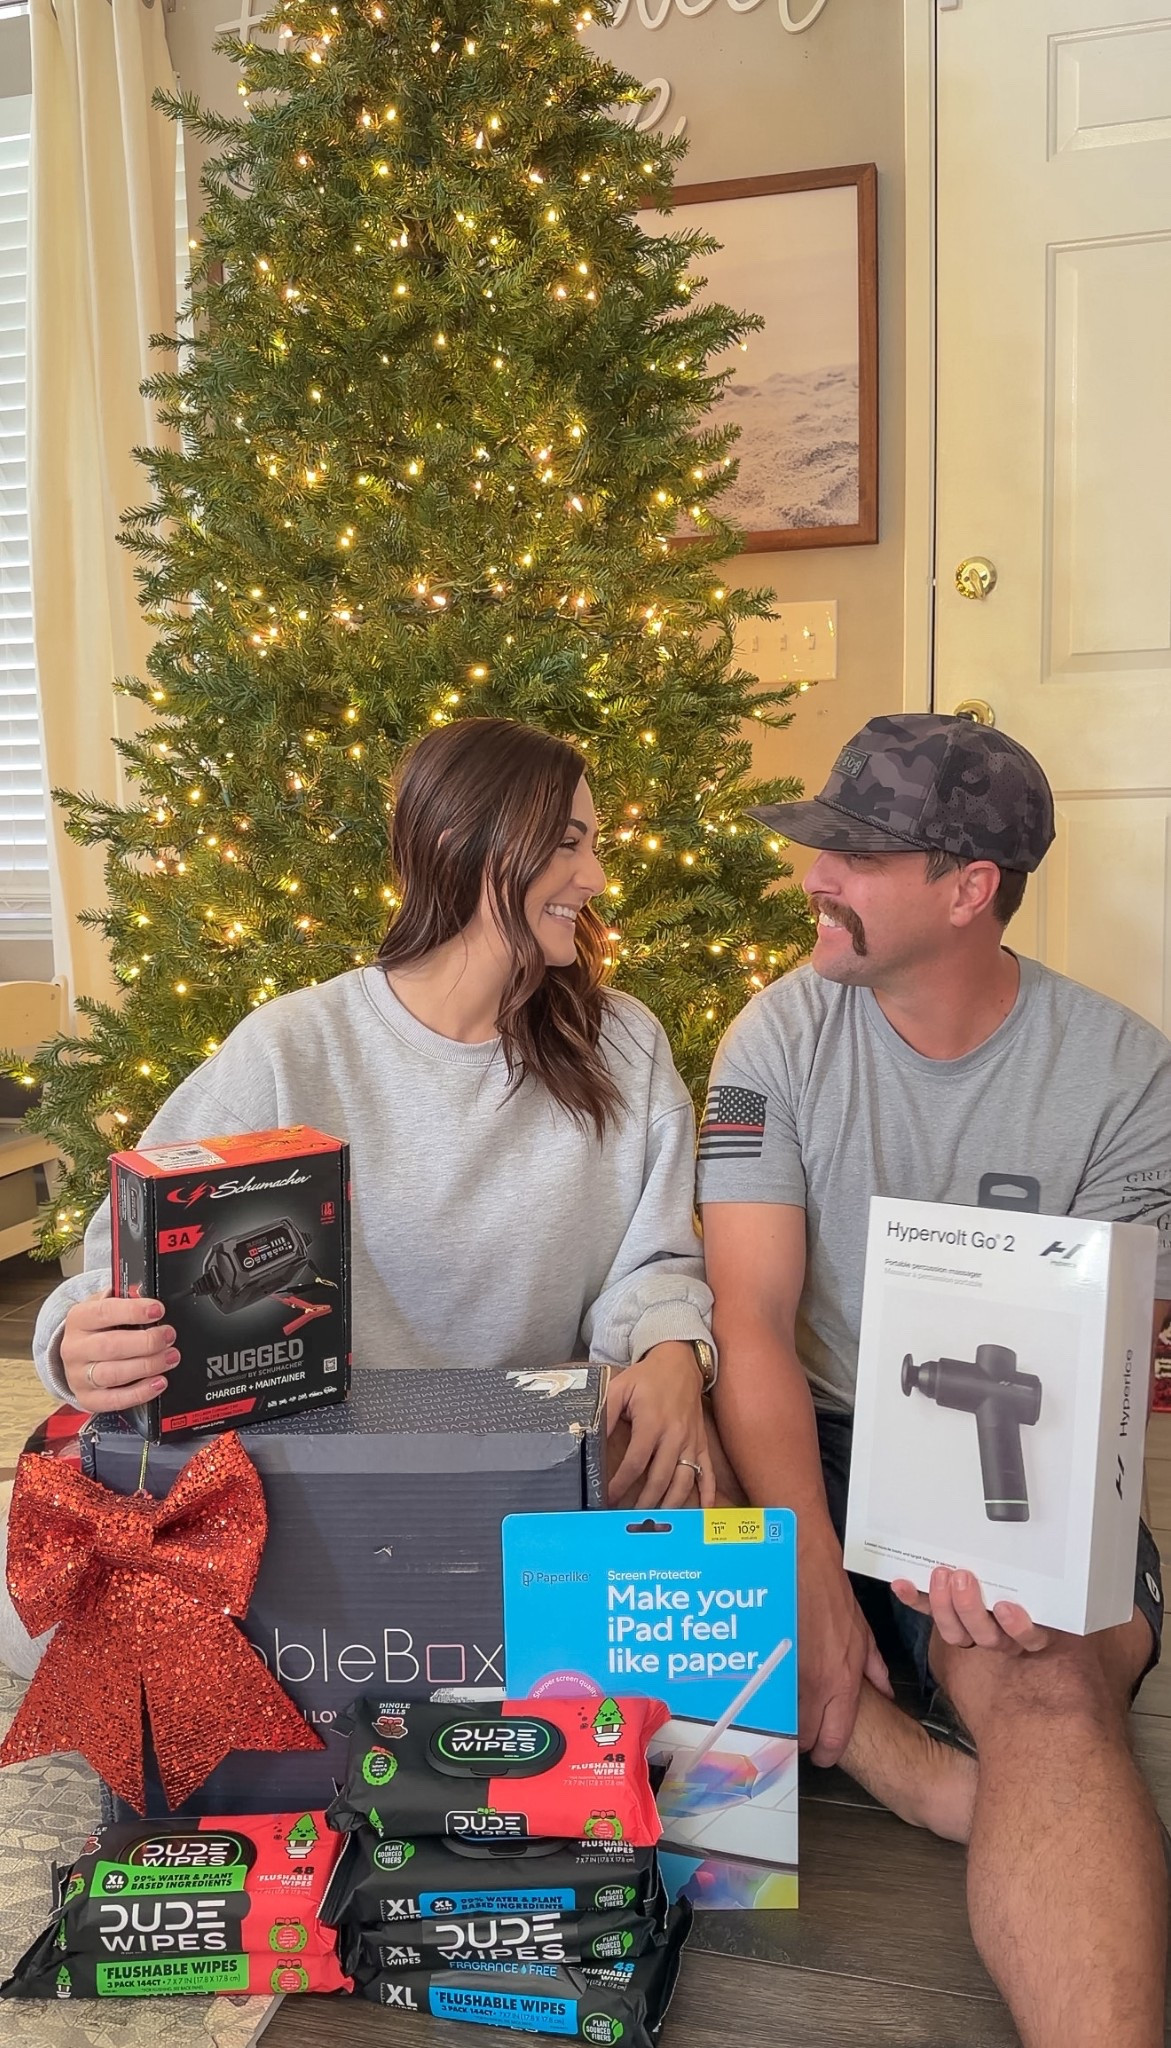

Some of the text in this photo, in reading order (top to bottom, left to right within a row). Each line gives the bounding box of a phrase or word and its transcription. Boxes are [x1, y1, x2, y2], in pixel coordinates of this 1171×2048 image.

[210, 1169, 311, 1199] Schumacher
[887, 1221, 968, 1246] Hypervolt
[1003, 1235, 1015, 1252] 2
[207, 1339, 304, 1379] RUGGED
[258, 1360, 304, 1376] SCHUMACHER
[205, 1385, 247, 1401] CHARGER
[255, 1371, 306, 1390] MAINTAINER
[1120, 1349, 1133, 1436] Hyperice
[771, 1526, 778, 1535] 2
[537, 1572, 589, 1585] Paperlike
[607, 1569, 702, 1581] Screen Protector
[608, 1584, 768, 1616] Make your
[608, 1614, 737, 1642] iPad feel
[608, 1647, 763, 1679] like paper.
[533, 1679, 555, 1699] Sharper
[579, 1680, 598, 1697] quality
[452, 1728, 537, 1742] DUDE
[451, 1741, 535, 1752] WIPES
[603, 1753, 626, 1762] 48
[453, 1816, 521, 1831] DUDE
[143, 1843, 230, 1857] DUDE
[142, 1856, 226, 1867] WIPES
[292, 1866, 315, 1875] 48
[106, 1875, 125, 1885] XL
[131, 1880, 233, 1890] BASED INGREDIENTS
[386, 1899, 421, 1917] XL
[434, 1901, 453, 1909] XL
[461, 1902, 494, 1910] BASED
[100, 1900, 226, 1933] DUDE
[435, 1912, 563, 1950] DUDE
[101, 1932, 227, 1951] WIPES
[602, 1934, 620, 1942] PLANT
[386, 1946, 421, 1958] XL
[438, 1943, 566, 1961] WIPES
[596, 1941, 621, 1950] SOURCED
[601, 1949, 621, 1957] FIBERS
[191, 1960, 237, 1973] WIPES
[386, 1957, 421, 1966] WIPES
[613, 1962, 635, 1972] 48
[450, 1962, 558, 1977] FRAGRANCE FREE
[137, 1979, 161, 1987] 144CT
[194, 1976, 209, 1985] (17.8
[230, 1974, 241, 1982] cm)
[386, 1983, 418, 2007] XL
[520, 1998, 566, 2015] WIPES
[592, 2019, 611, 2028] PLANT
[586, 2026, 611, 2035] SOURCED
[591, 2033, 611, 2042] FIBERS
